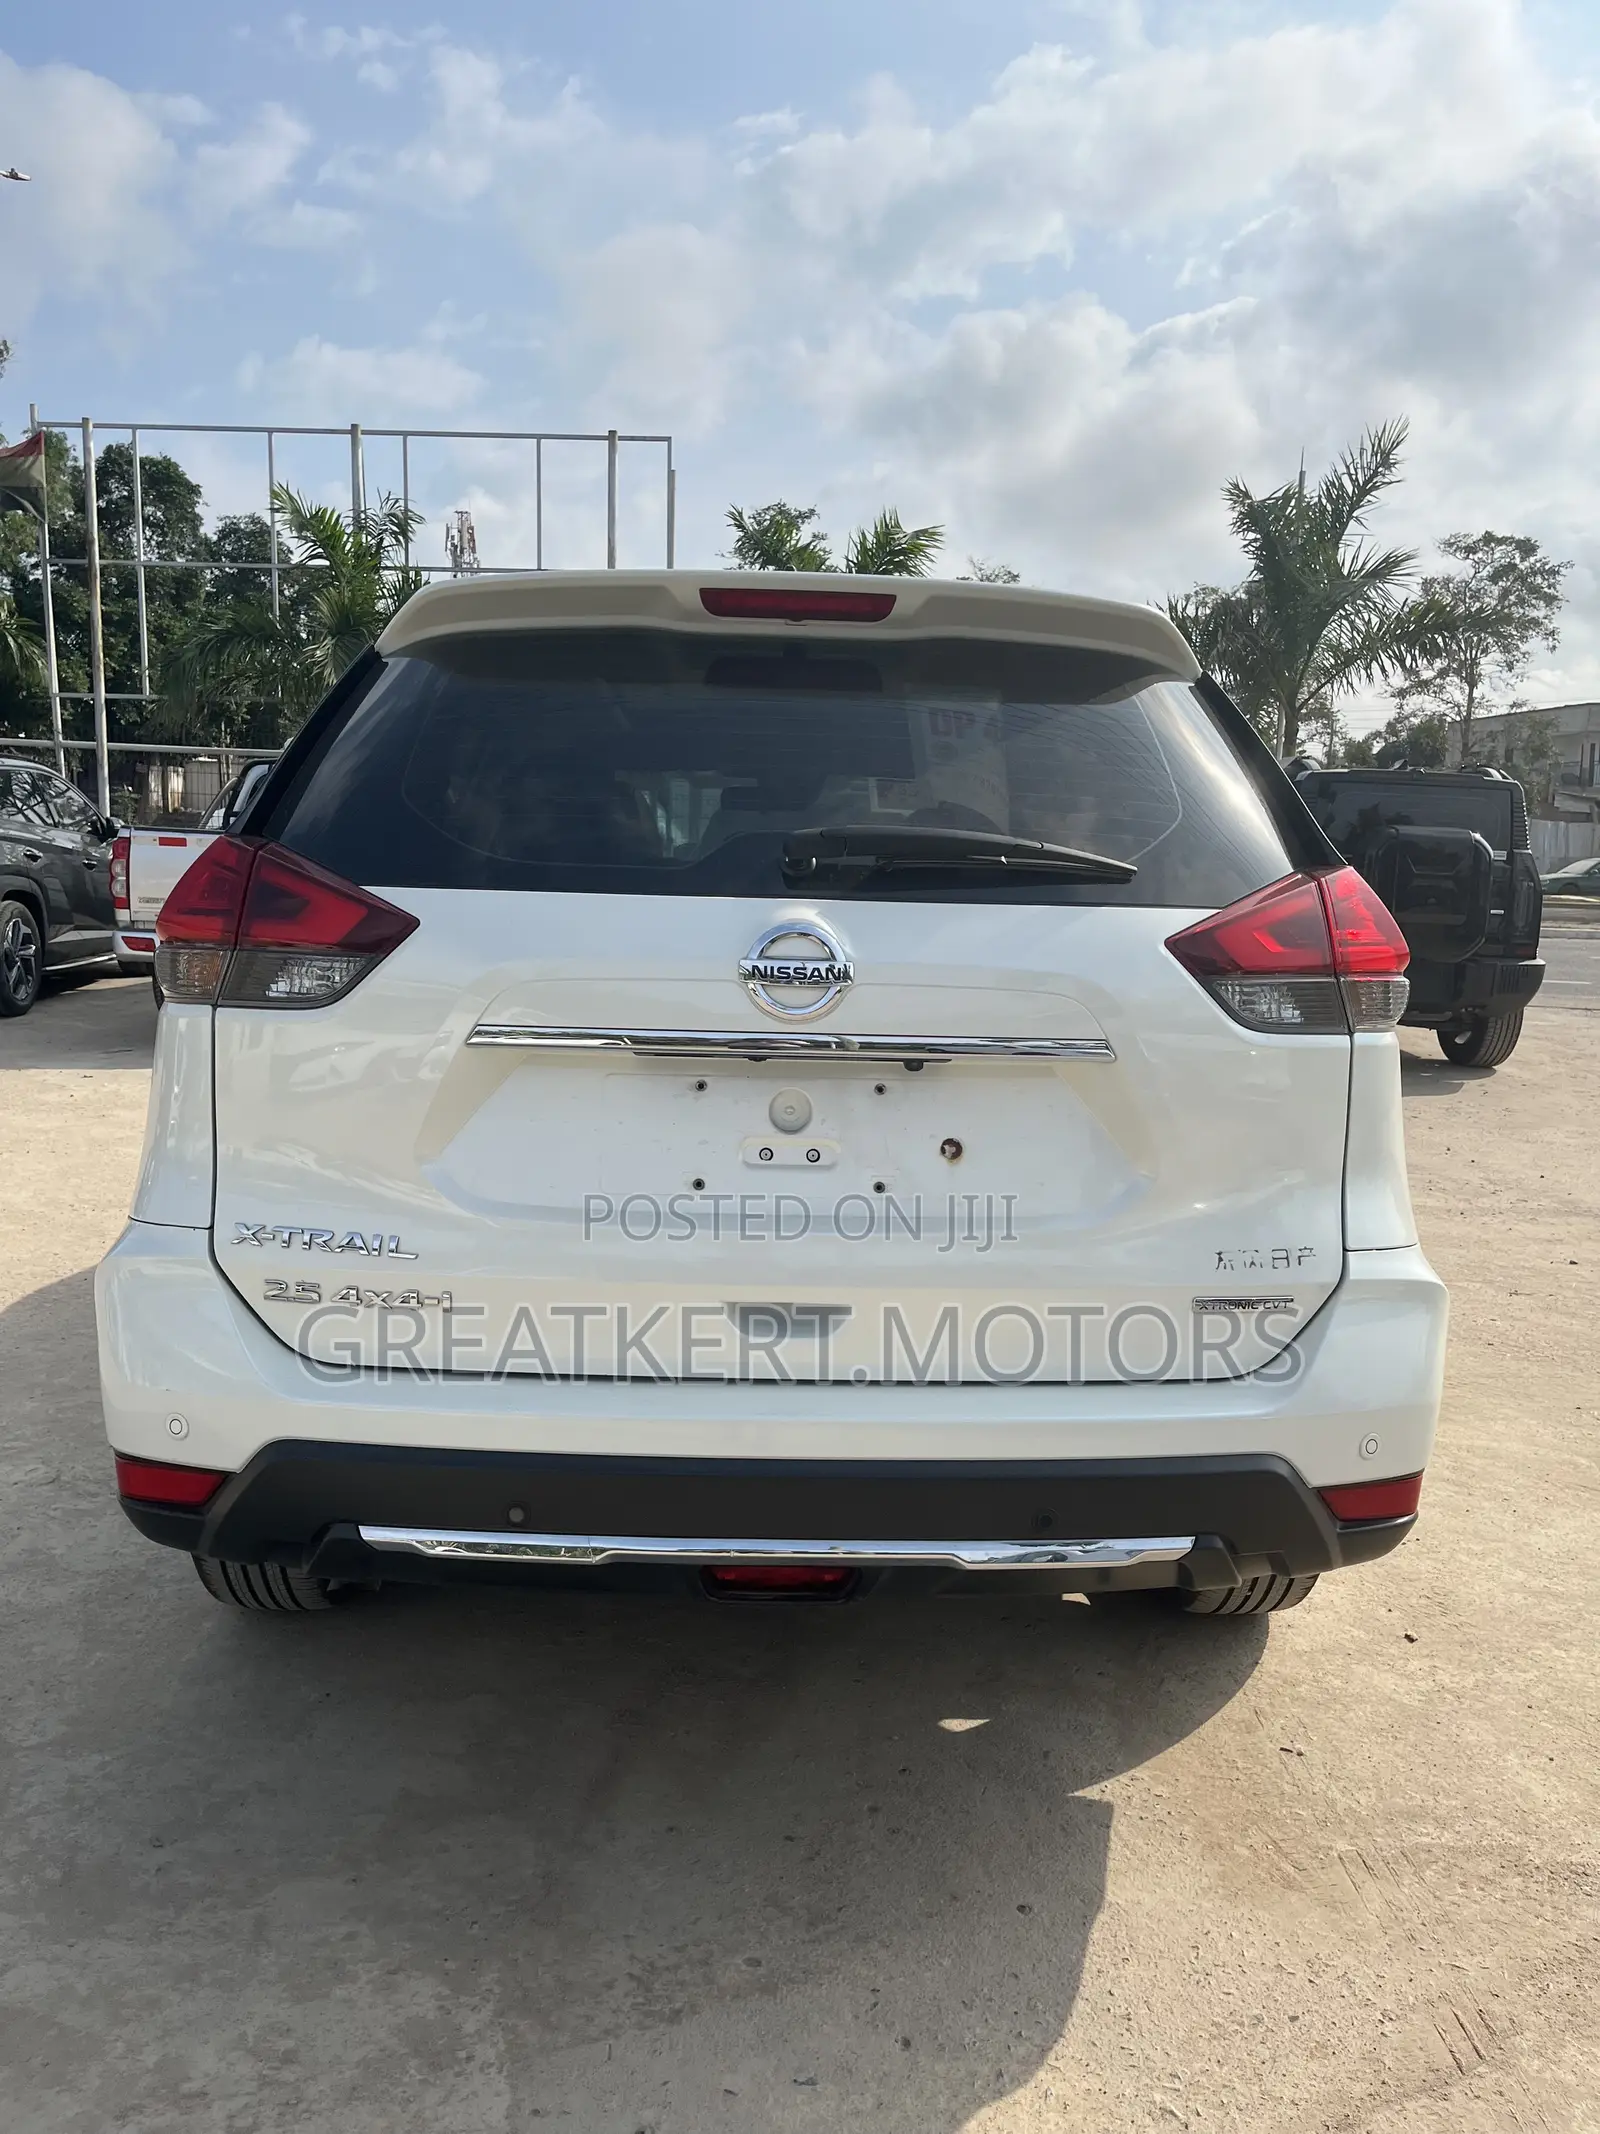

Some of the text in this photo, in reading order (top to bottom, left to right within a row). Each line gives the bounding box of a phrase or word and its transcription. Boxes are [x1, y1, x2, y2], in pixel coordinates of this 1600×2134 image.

[751, 964, 842, 981] NISSAN
[231, 1222, 419, 1260] X-TRAIL
[1263, 1300, 1290, 1310] CVT
